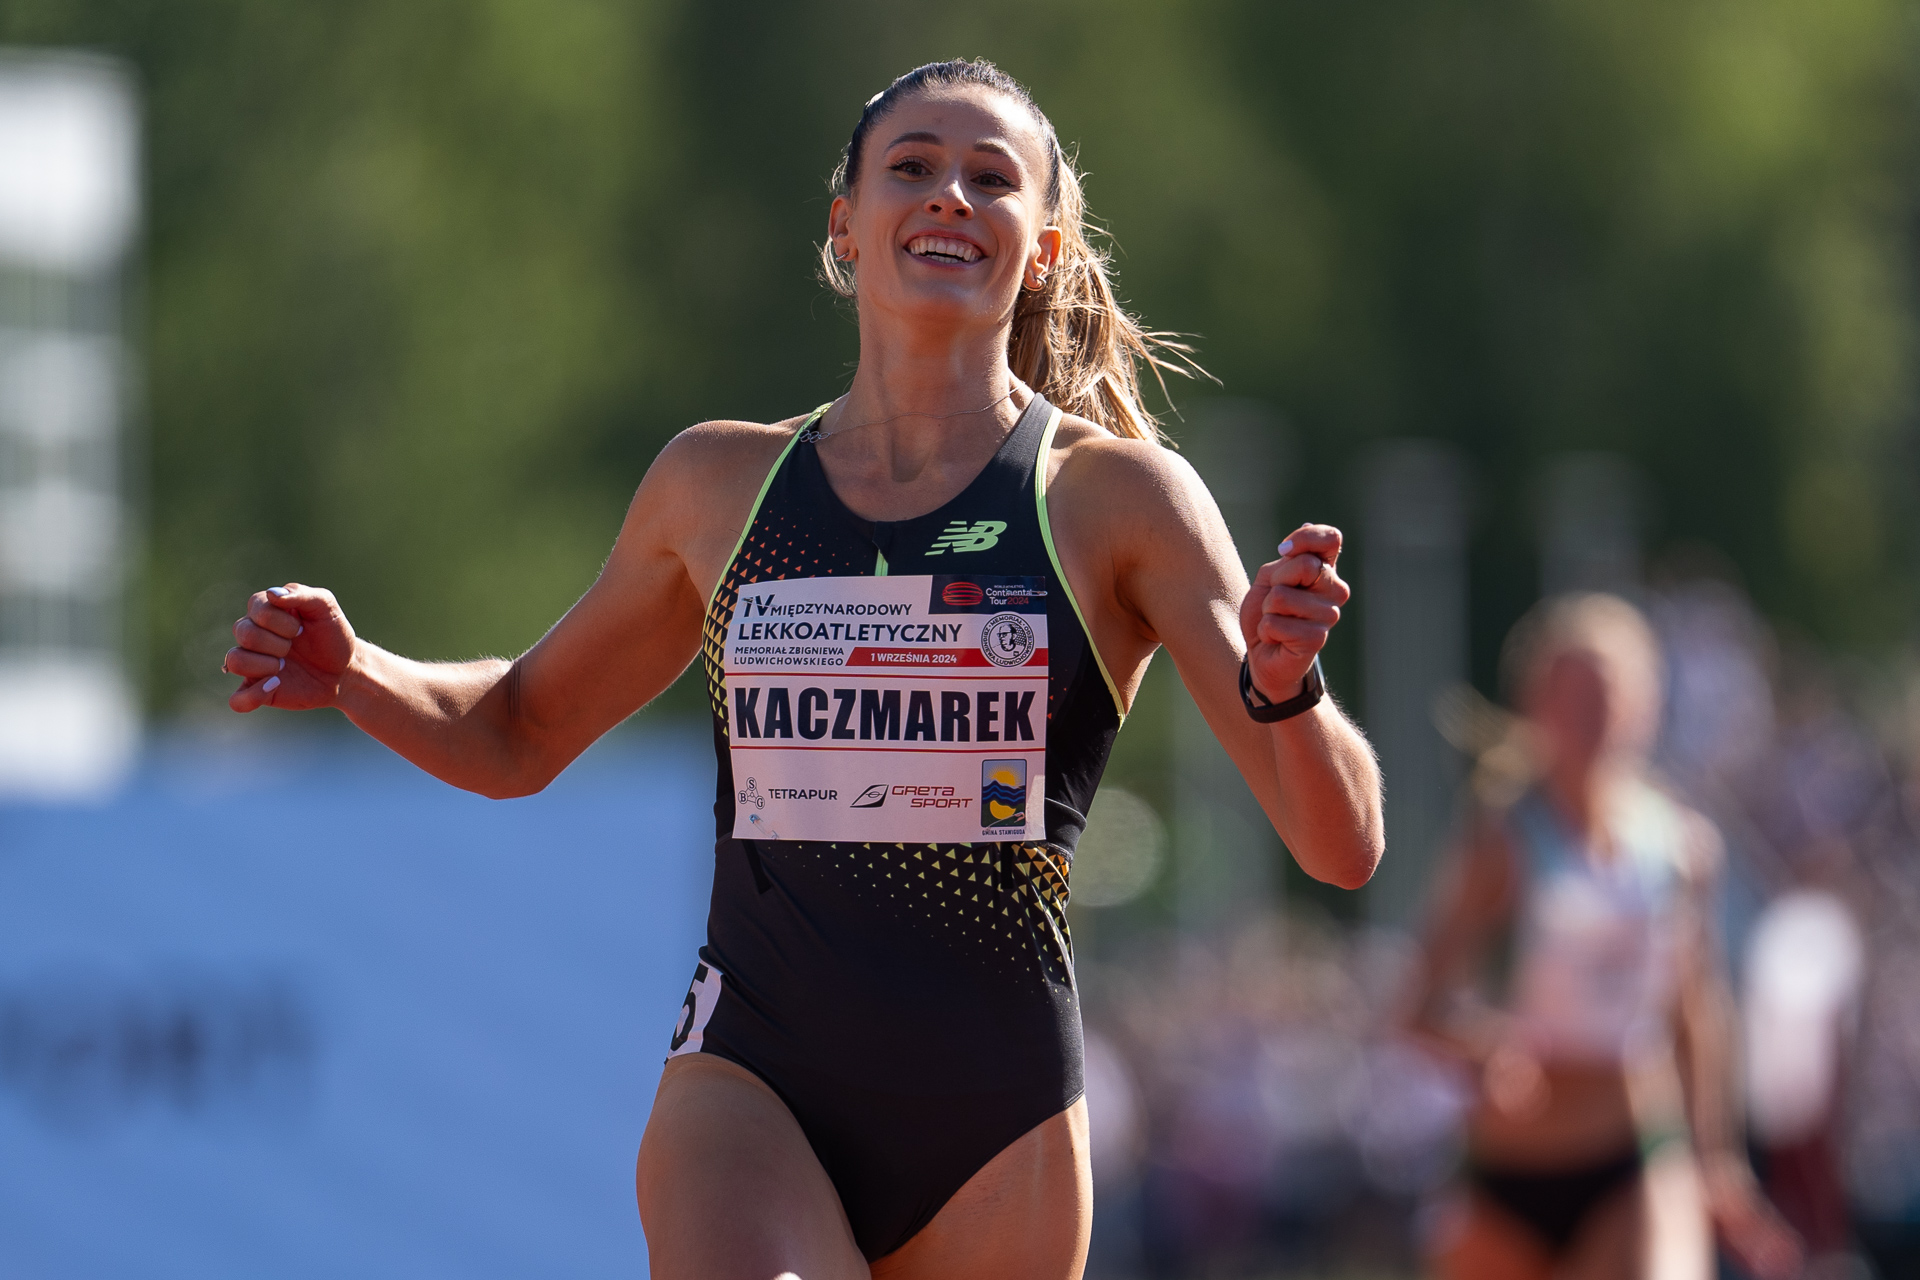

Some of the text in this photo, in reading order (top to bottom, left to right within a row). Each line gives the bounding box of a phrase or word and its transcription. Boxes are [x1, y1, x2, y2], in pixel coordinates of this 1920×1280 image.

[743, 594, 913, 617] IV MIĘDZYNARODOWY
[738, 622, 963, 643] LEKKOATLETYCZNY
[734, 646, 844, 655] MEMORIAŁ ZBIGNIEWA
[734, 656, 844, 666] LUDWICHOWSKIEGO
[871, 652, 957, 663] 1 WRZEŚNIA 2024
[734, 687, 1036, 742] KACZMAREK
[768, 788, 838, 801] TETRAPUR
[910, 798, 973, 808] SPORT
